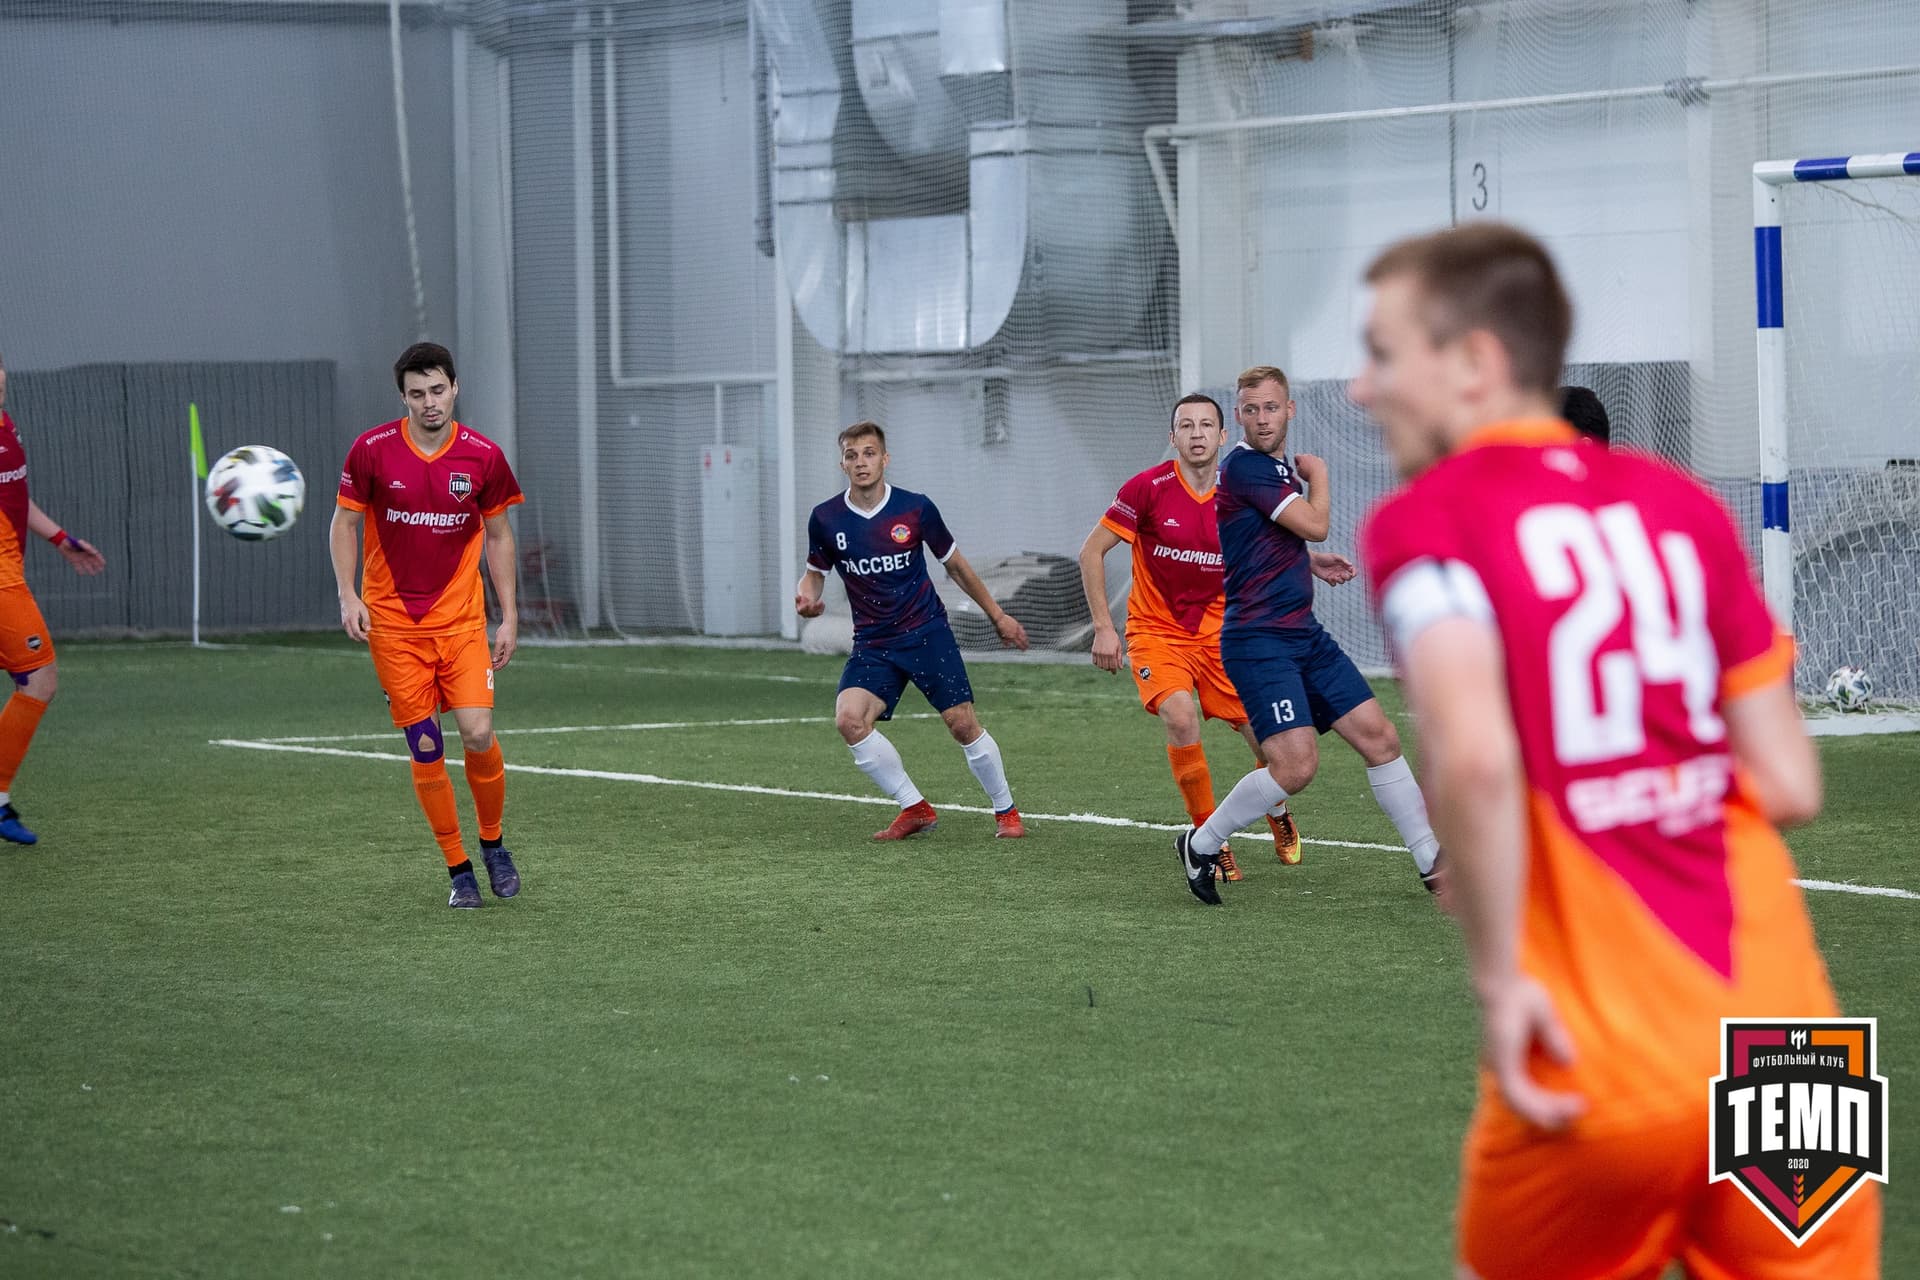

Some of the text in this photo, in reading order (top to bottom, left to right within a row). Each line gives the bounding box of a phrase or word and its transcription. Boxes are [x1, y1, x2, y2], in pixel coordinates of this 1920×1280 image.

[1472, 161, 1488, 211] 3
[386, 508, 470, 527] ПРОДИНВЕСТ
[835, 532, 847, 551] 8
[1153, 544, 1224, 566] ПРОДИНВЕ
[1515, 501, 1725, 767] 24
[1272, 700, 1295, 724] 13
